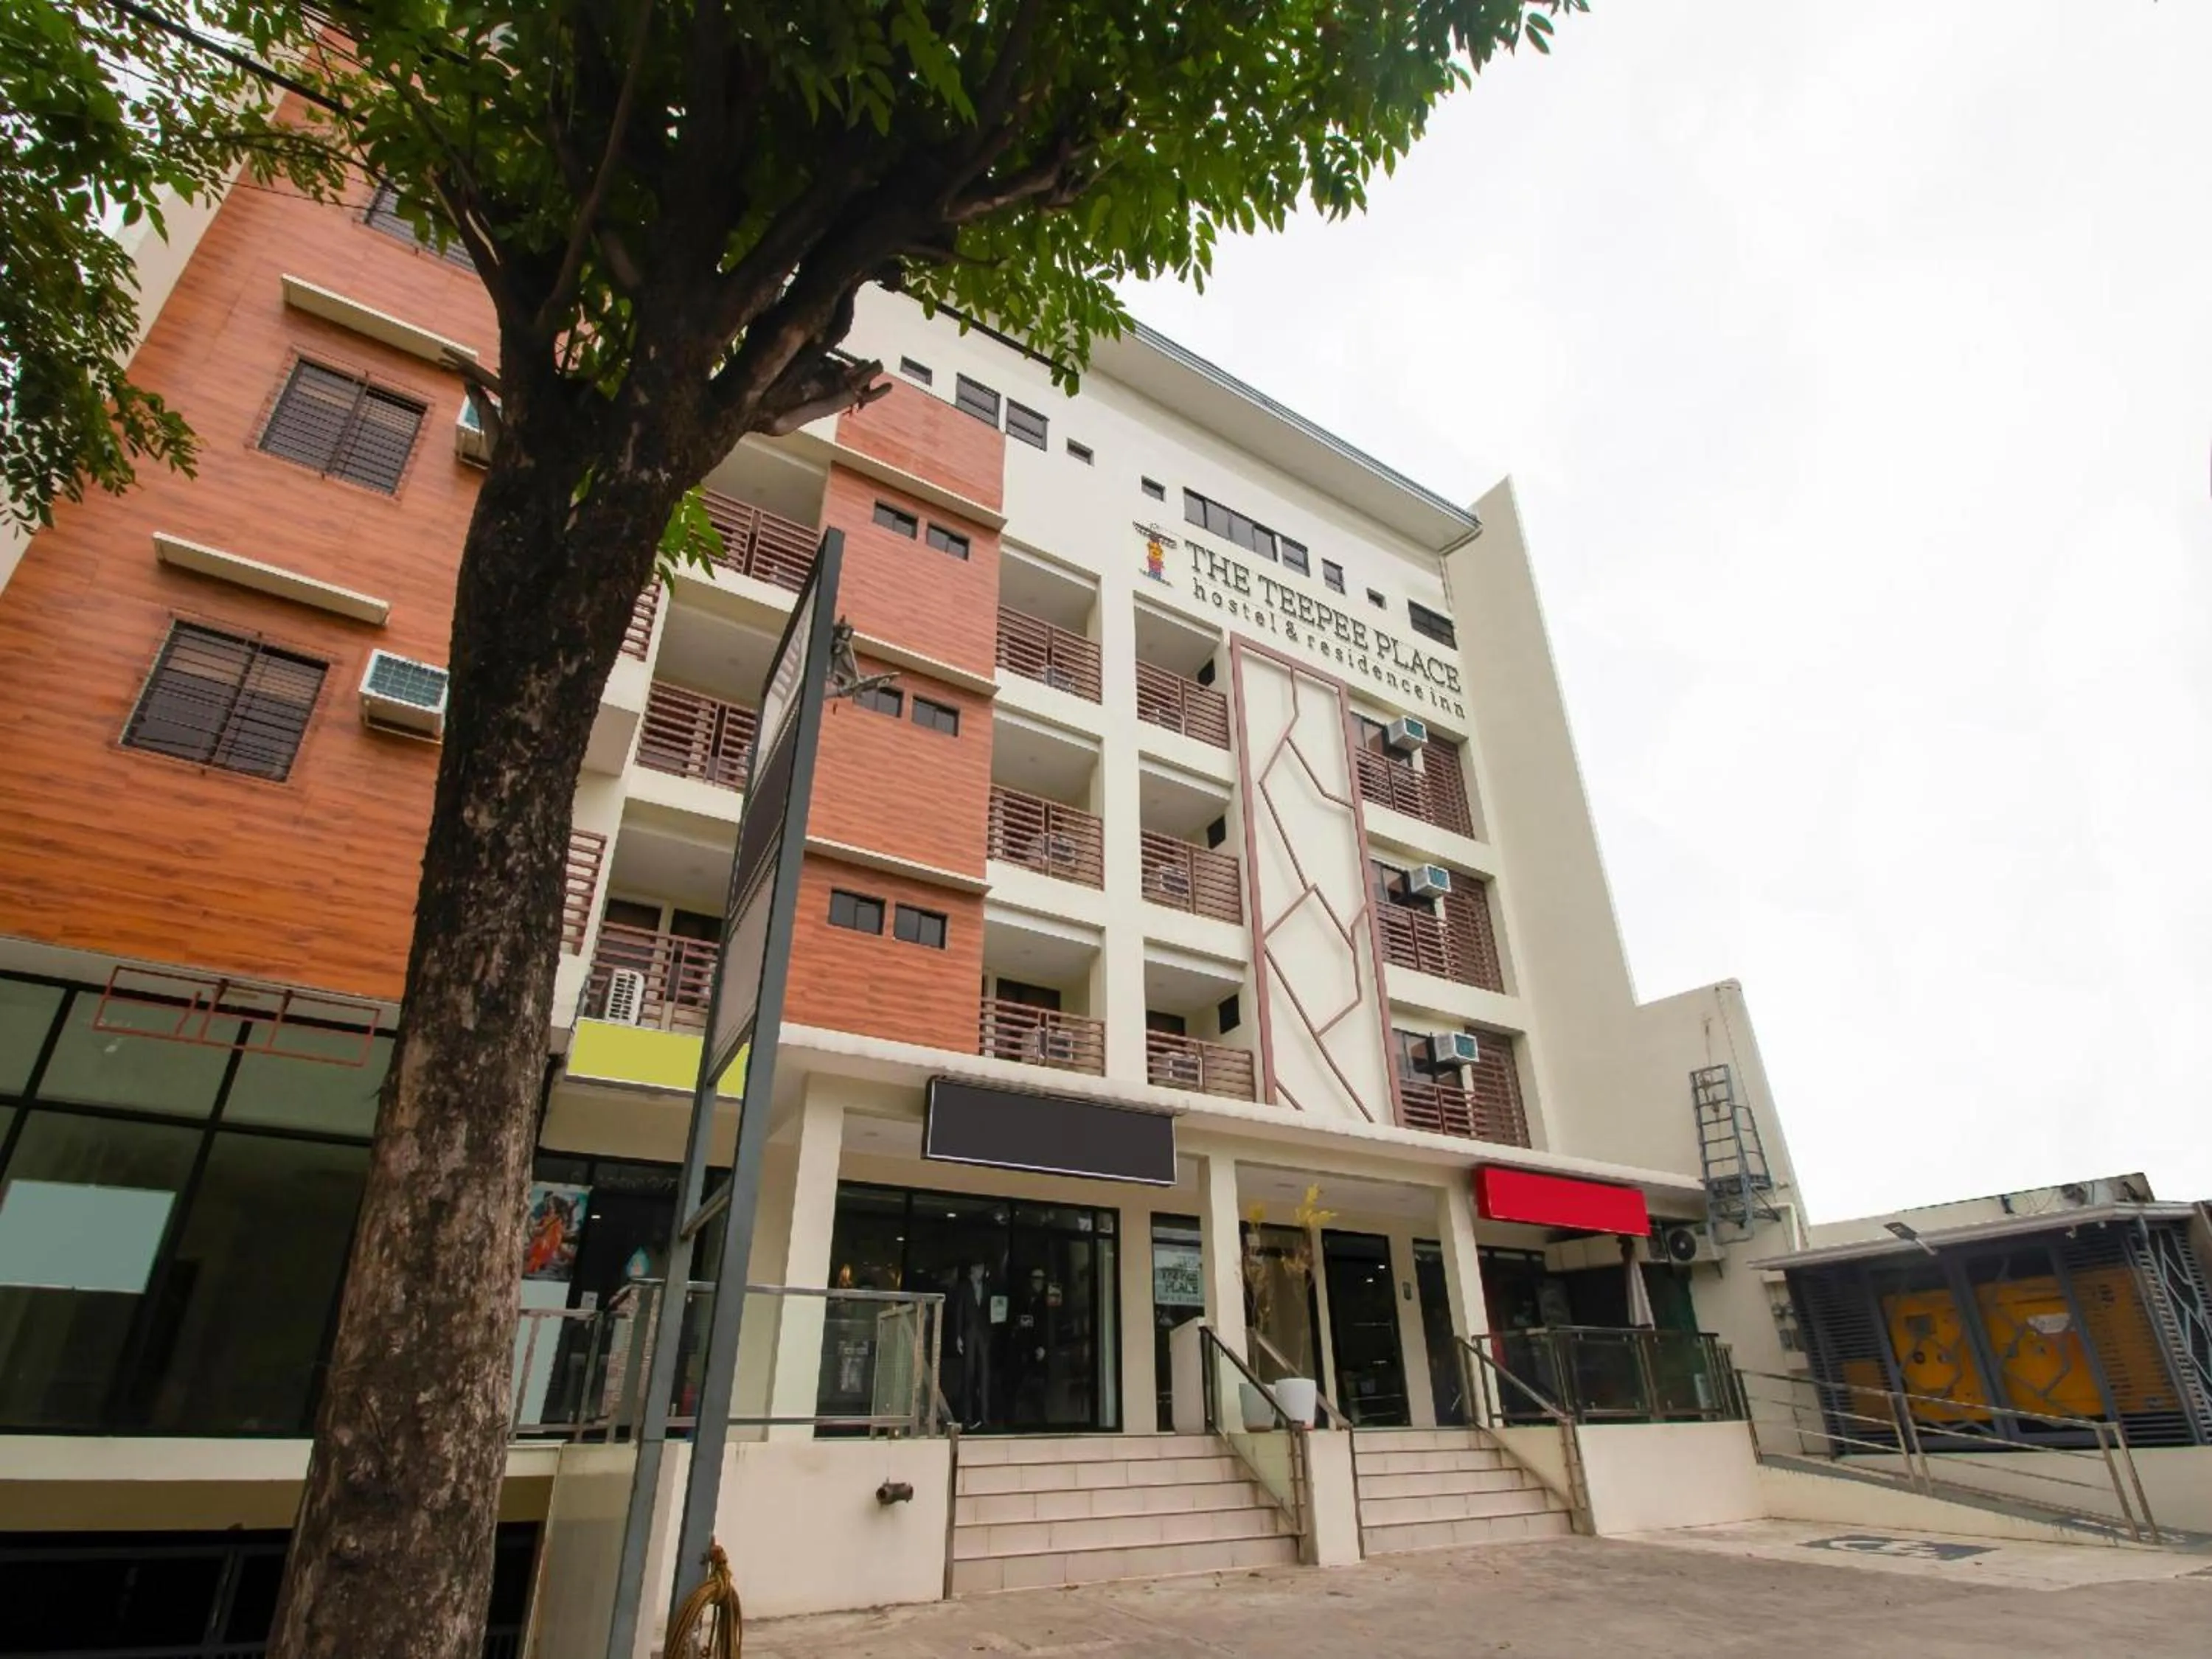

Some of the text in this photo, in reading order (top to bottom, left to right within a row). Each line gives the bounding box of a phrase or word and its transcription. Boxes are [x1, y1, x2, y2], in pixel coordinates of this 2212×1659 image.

[1184, 540, 1462, 693] THE TEEPEE PLACE
[1192, 578, 1466, 720] hostel & residence inn
